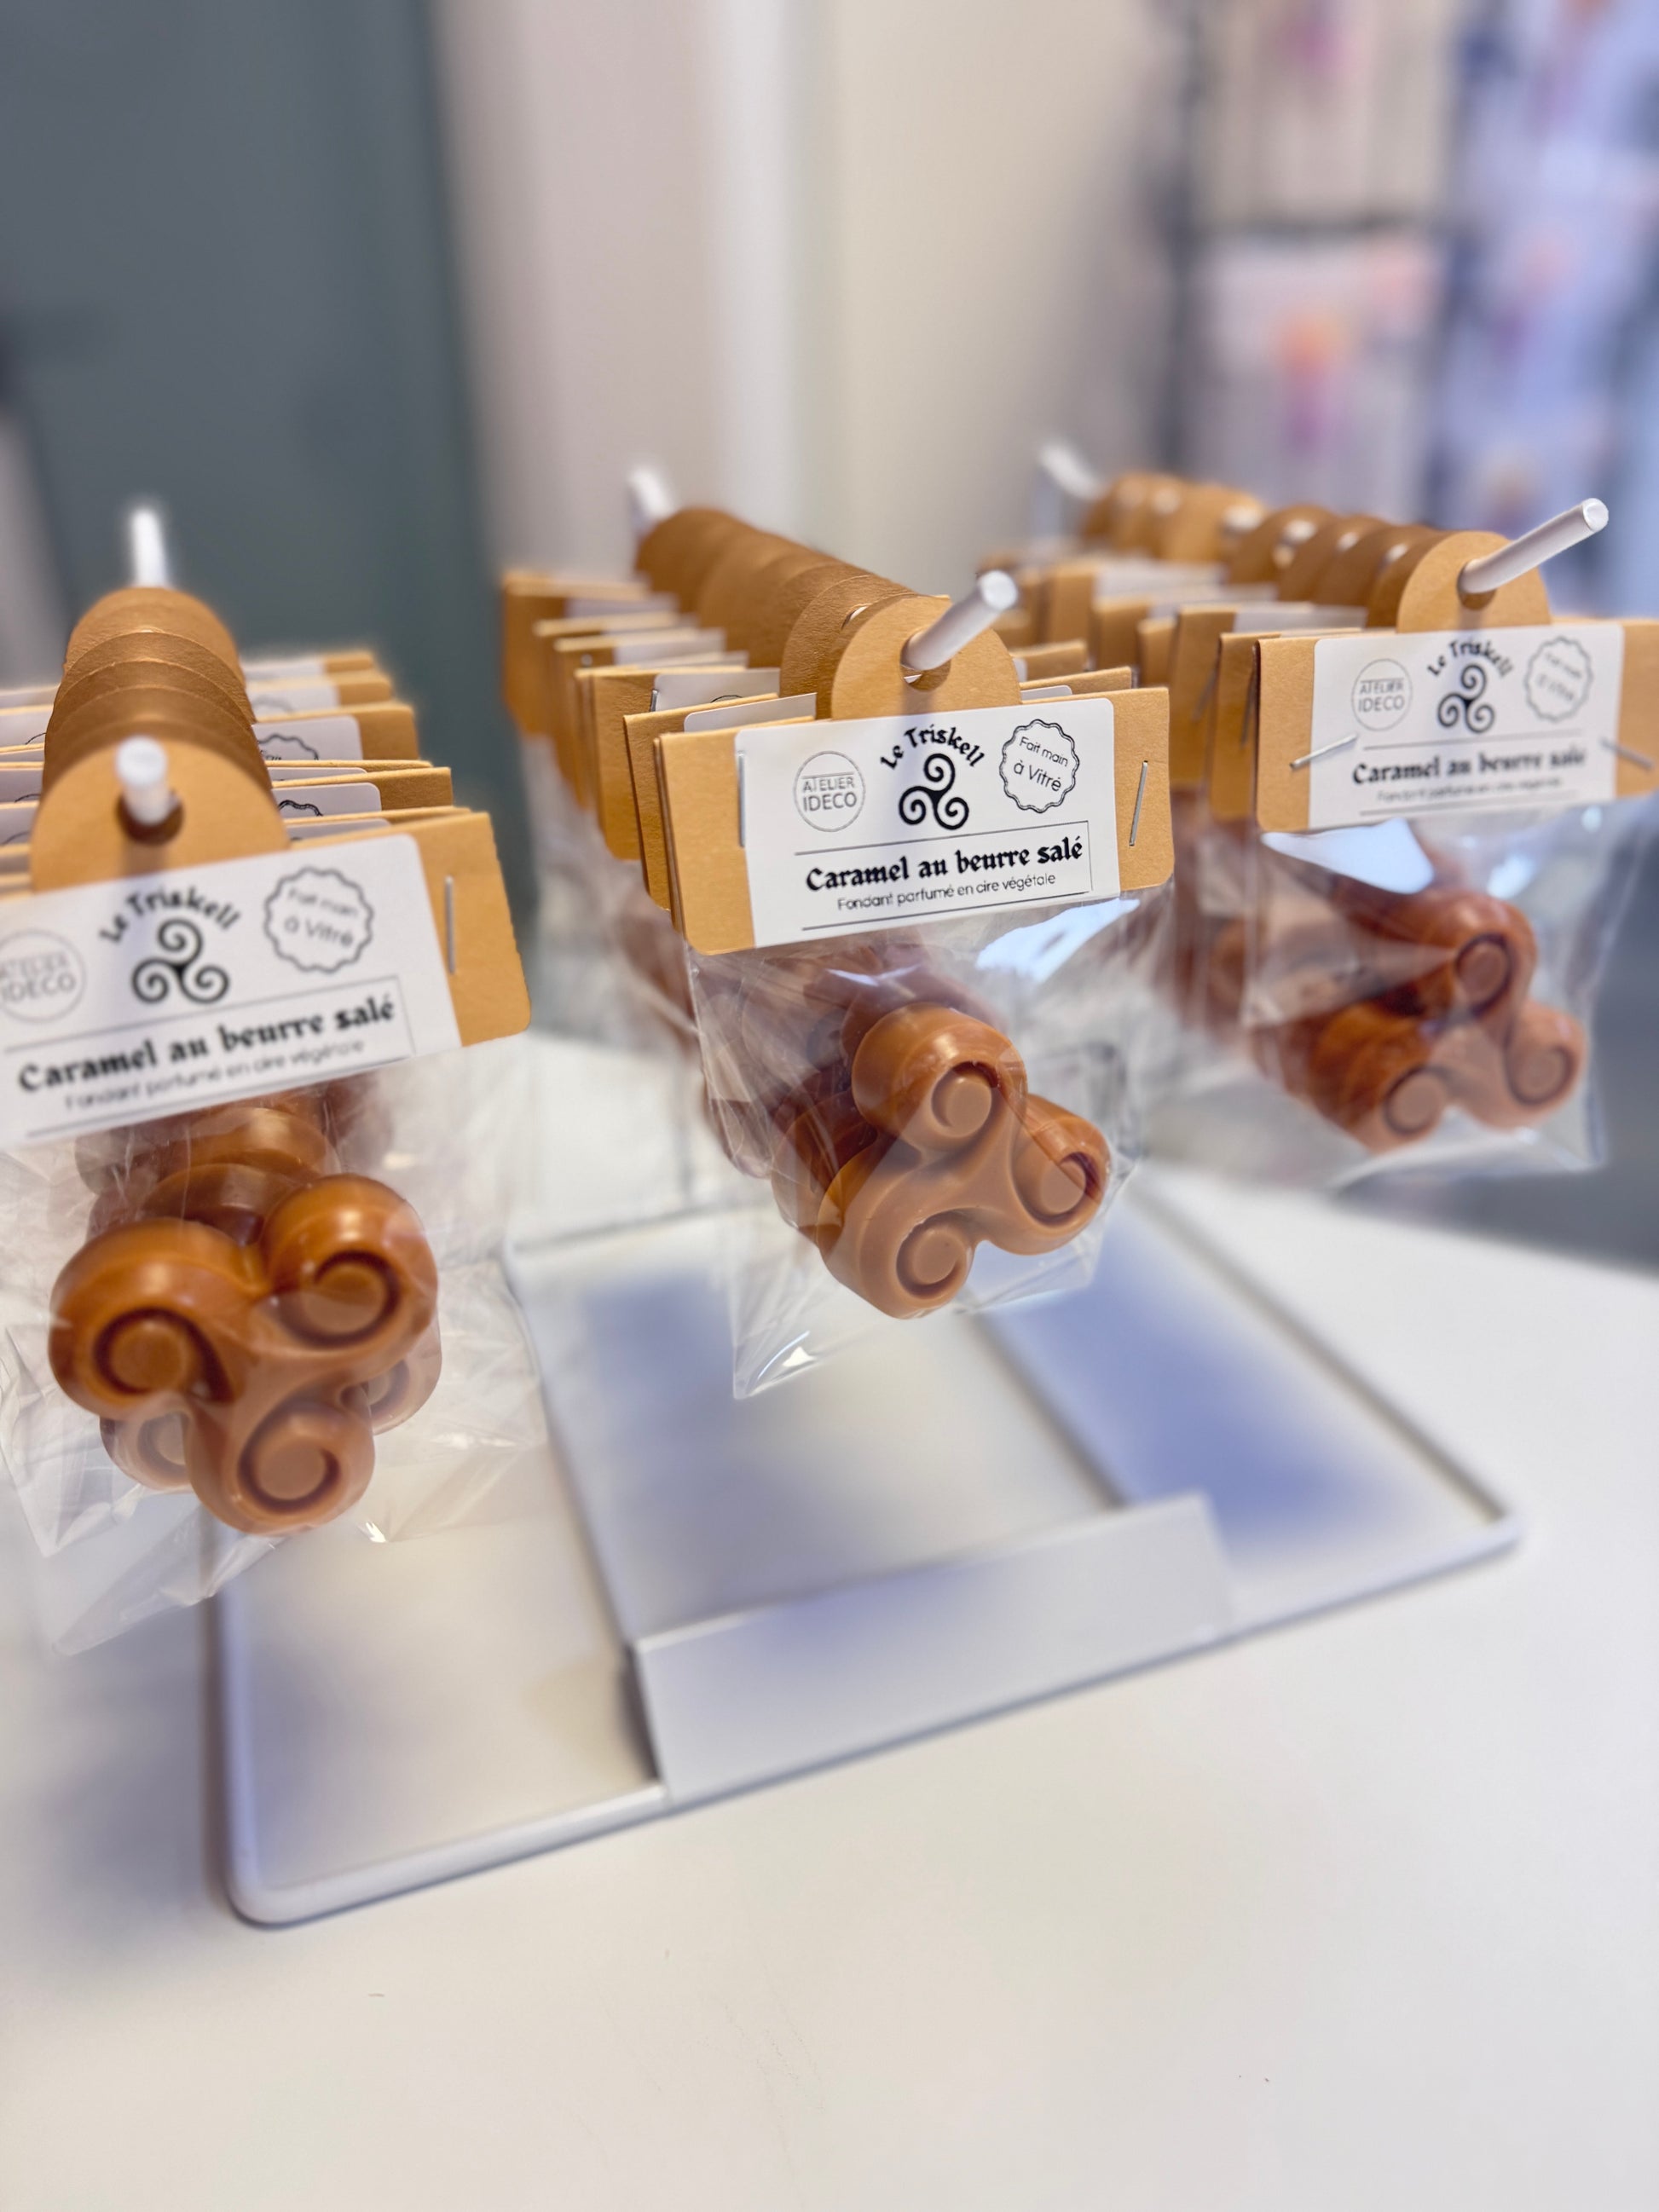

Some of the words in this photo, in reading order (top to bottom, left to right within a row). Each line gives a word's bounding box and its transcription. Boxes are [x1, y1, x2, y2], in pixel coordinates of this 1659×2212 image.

[1426, 655, 1448, 677] Le
[1358, 695, 1405, 713] IDECO
[1359, 681, 1405, 696] ATELIER
[880, 744, 905, 771] Le
[904, 724, 986, 768] Triskell
[1018, 736, 1042, 757] Fait
[1041, 748, 1070, 768] main
[802, 777, 856, 793] ATELIER
[1013, 760, 1025, 777] à
[1027, 764, 1063, 793] Vitré
[1352, 755, 1441, 785] Caramel
[1448, 758, 1472, 777] au
[803, 791, 858, 812] IDECO
[806, 855, 910, 892] Caramel
[918, 859, 949, 880] au
[957, 849, 1031, 875] beurre
[1038, 835, 1084, 865] salé
[837, 893, 894, 911] Fondant
[897, 884, 955, 907] parfumé
[957, 884, 974, 897] en
[976, 879, 1000, 894] cire
[1002, 872, 1056, 892] végétale
[98, 912, 129, 943] Le
[125, 887, 242, 930] Triskell
[19, 1037, 158, 1092] Caramel
[169, 1037, 210, 1063] au
[218, 1014, 326, 1054] beurre
[334, 992, 396, 1031] salé
